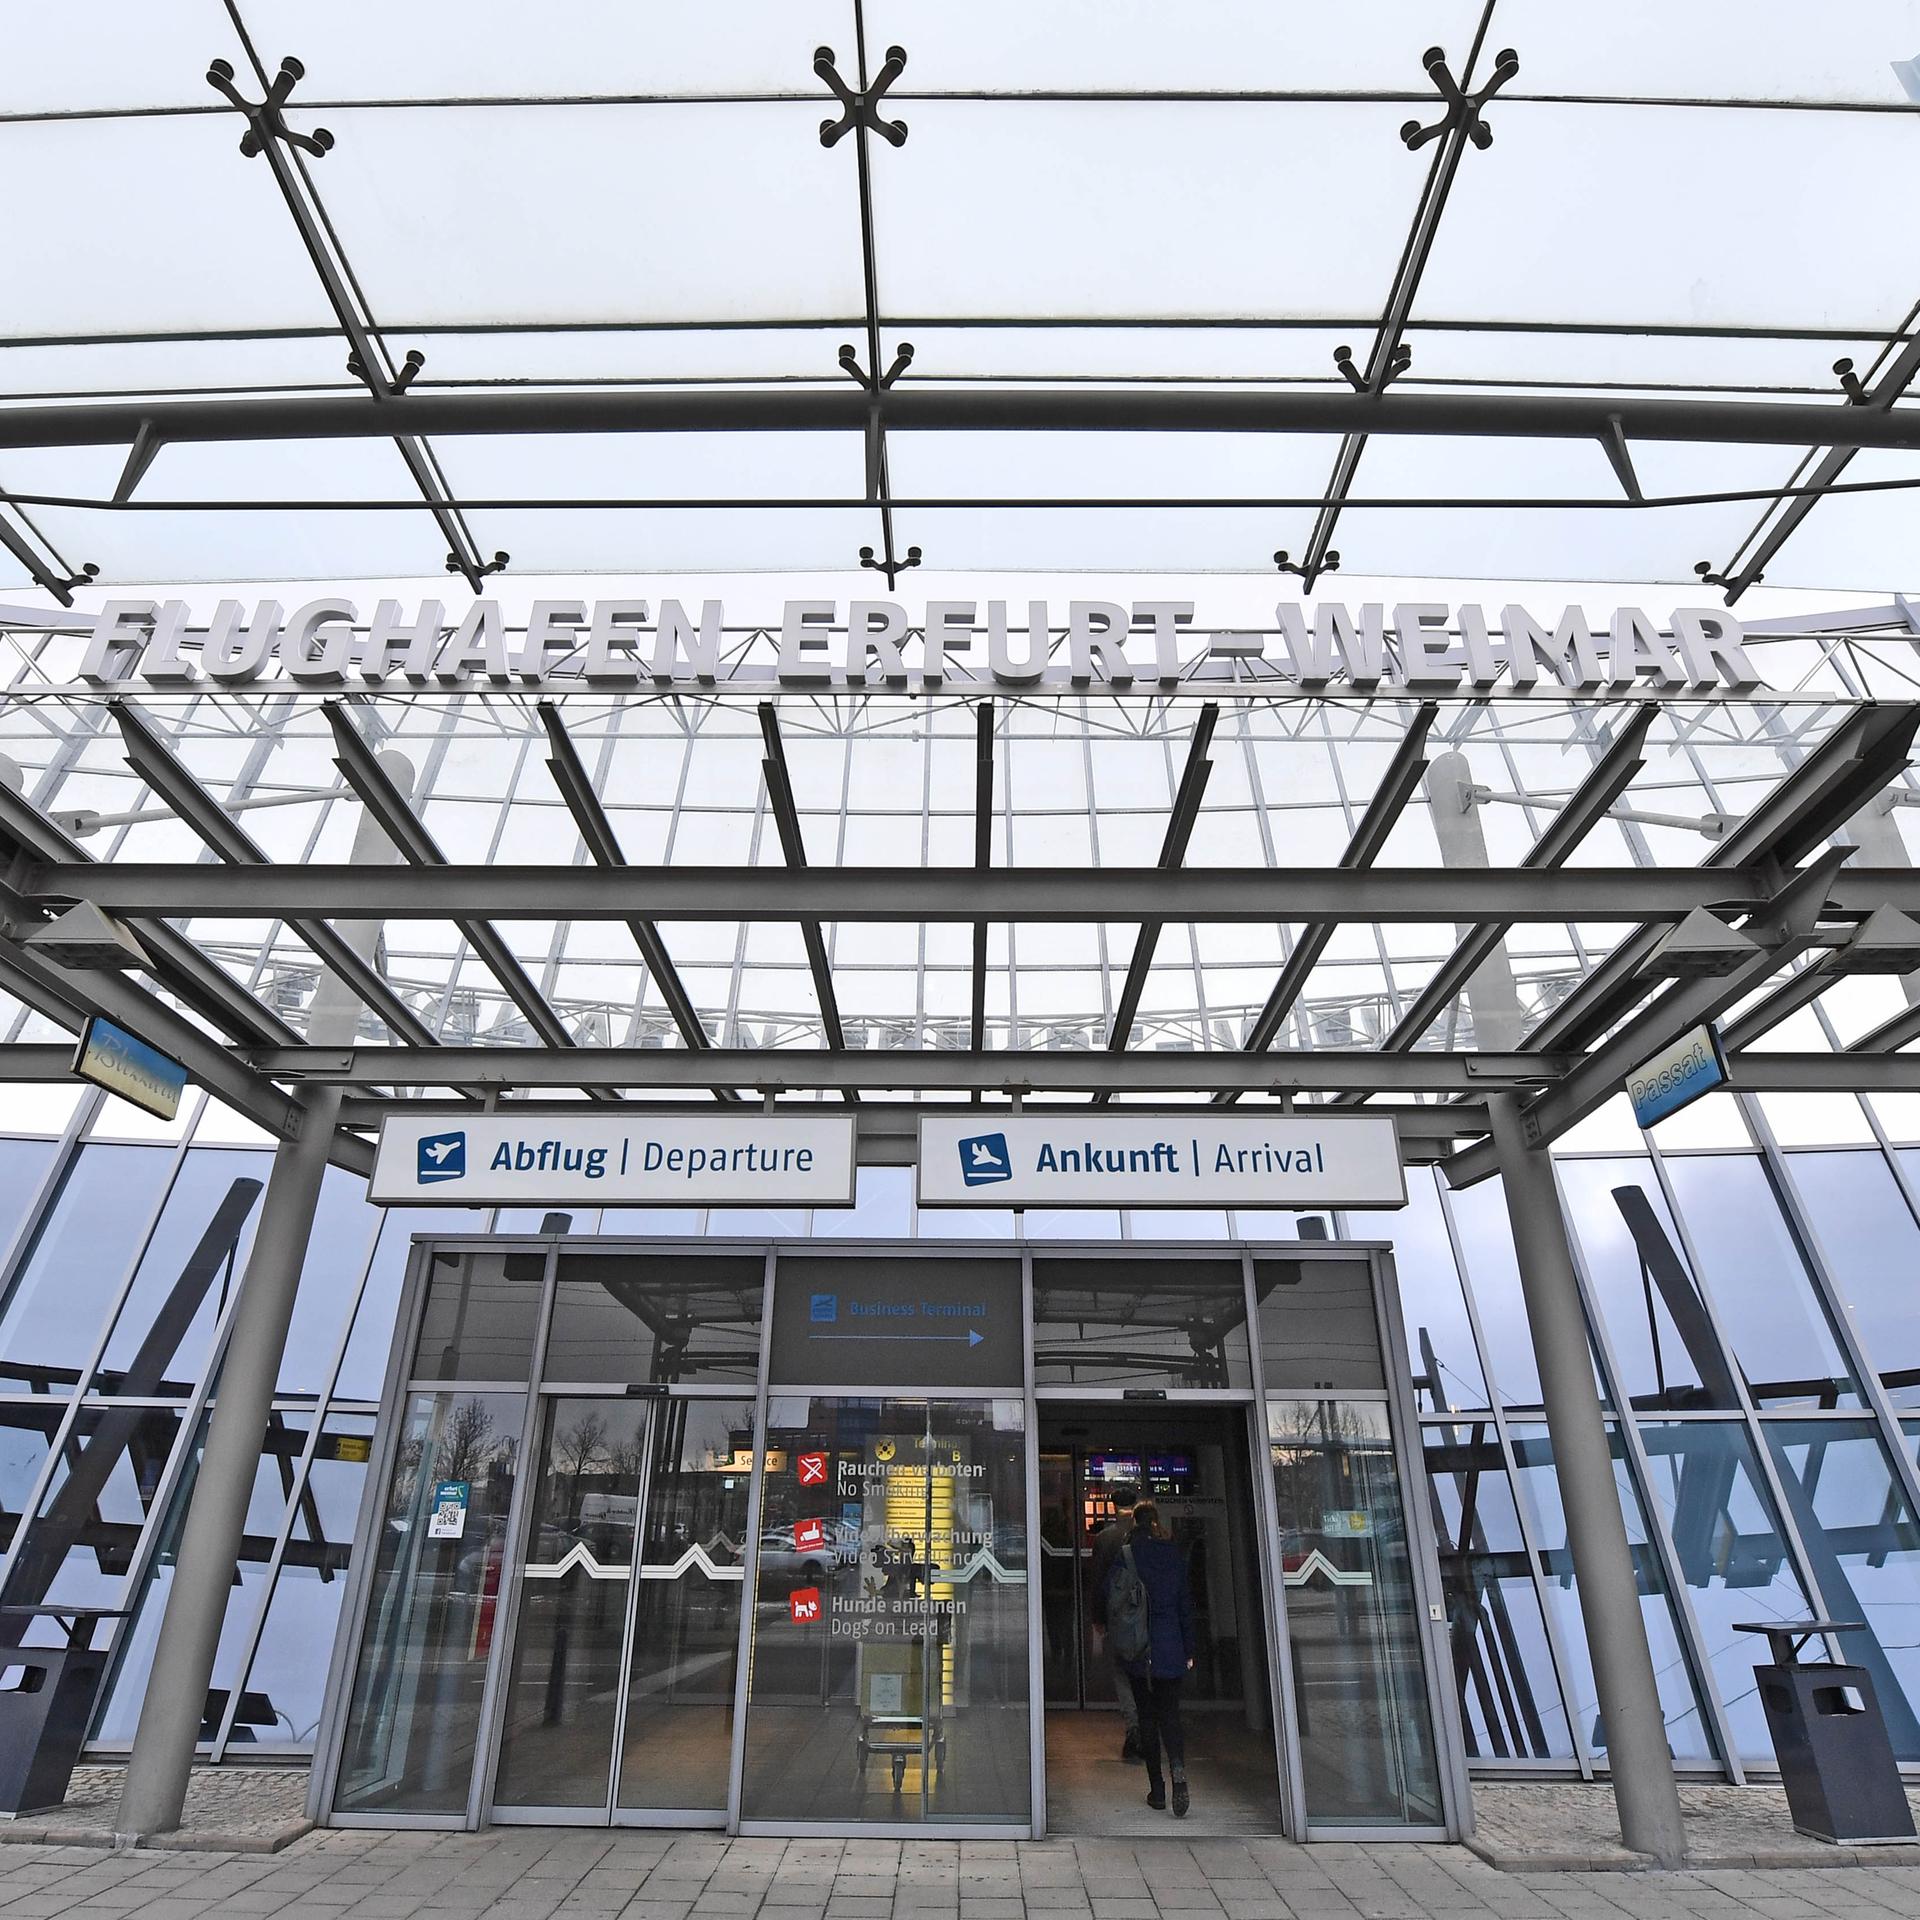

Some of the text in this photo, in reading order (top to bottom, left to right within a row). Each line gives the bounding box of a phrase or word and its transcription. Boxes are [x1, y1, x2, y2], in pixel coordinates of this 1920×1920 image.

[79, 598, 725, 684] FLUGHAFEN
[1631, 1042, 1708, 1110] Passat
[490, 1140, 608, 1178] Abflug
[643, 1141, 814, 1178] Departure
[1036, 1142, 1180, 1173] Ankunft
[1214, 1143, 1325, 1174] Arrival
[850, 1301, 987, 1317] Business Terminal
[740, 1455, 778, 1466] Sece
[952, 1450, 961, 1462] B
[838, 1461, 905, 1476] Rauchen
[837, 1481, 857, 1496] No
[835, 1549, 878, 1565] Video
[832, 1596, 967, 1614] Hunde anleinen
[832, 1618, 939, 1639] Dogs on Lead
